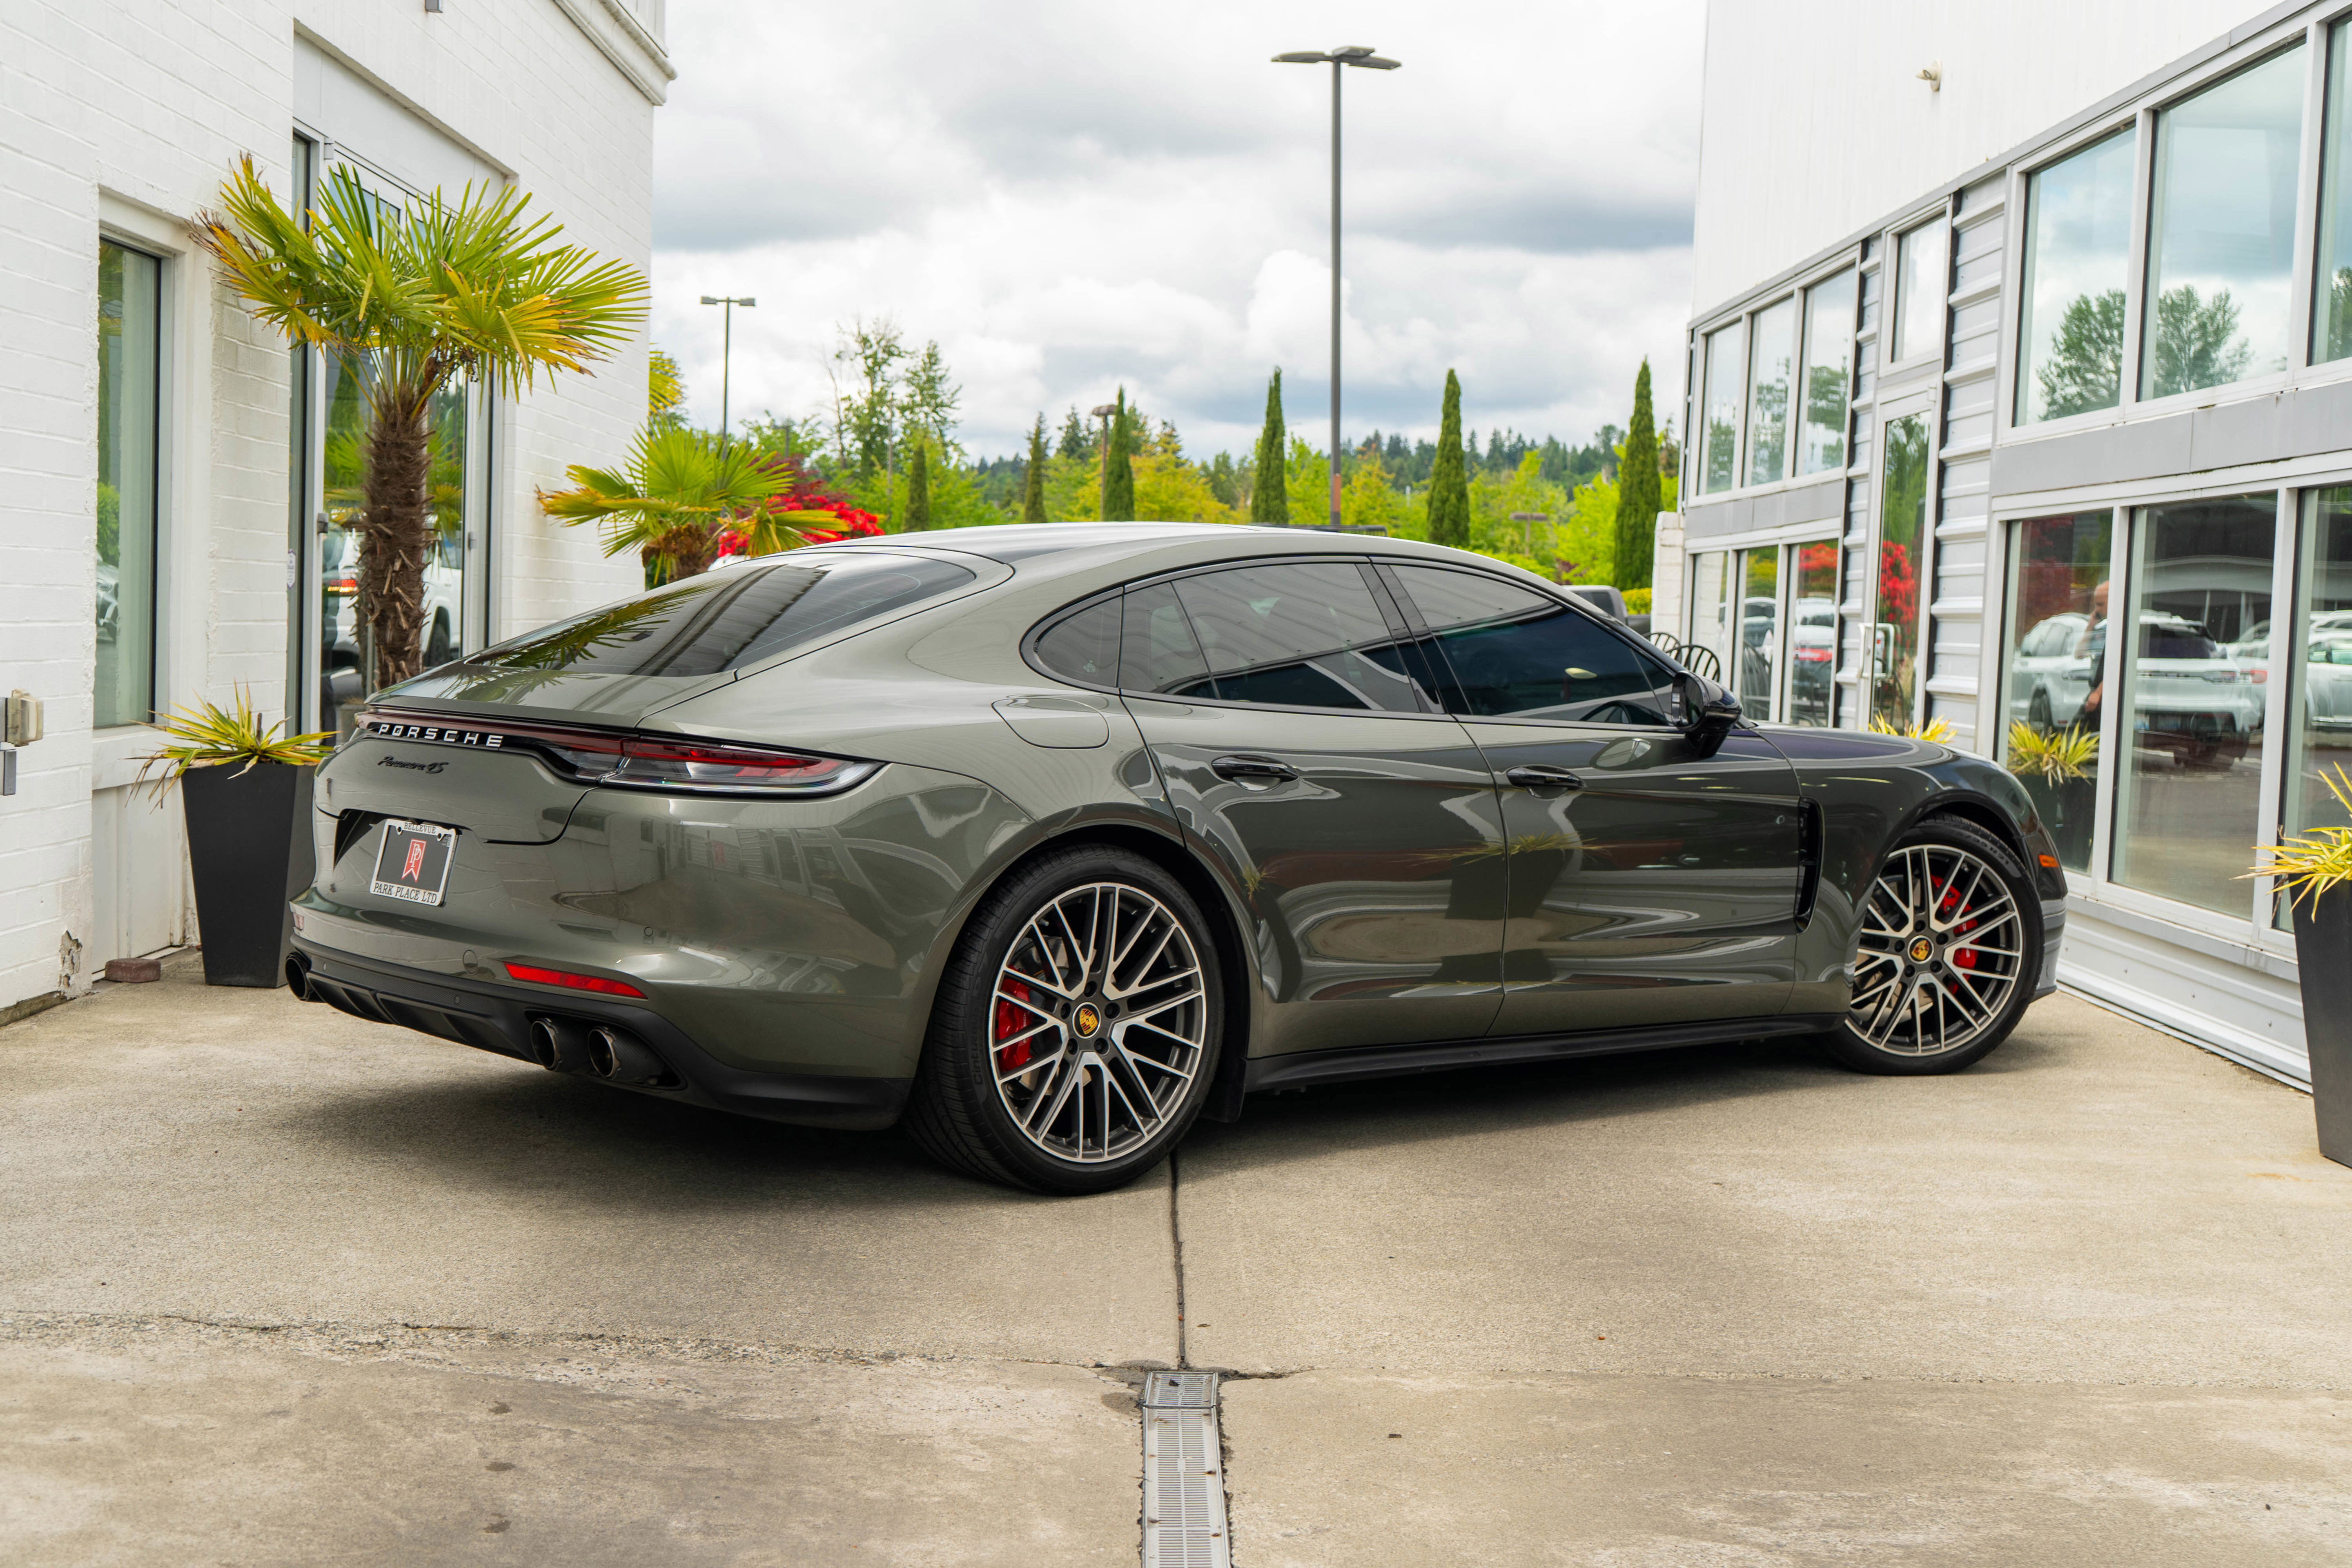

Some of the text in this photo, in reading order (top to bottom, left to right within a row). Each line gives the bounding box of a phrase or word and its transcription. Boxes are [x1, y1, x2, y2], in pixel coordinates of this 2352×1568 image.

[378, 724, 503, 747] PORSCHE
[377, 755, 426, 771] Panamera
[404, 822, 436, 834] BELLEVUE
[373, 882, 437, 904] PARK PLACE LTD
[970, 1007, 983, 1085] Cintu
